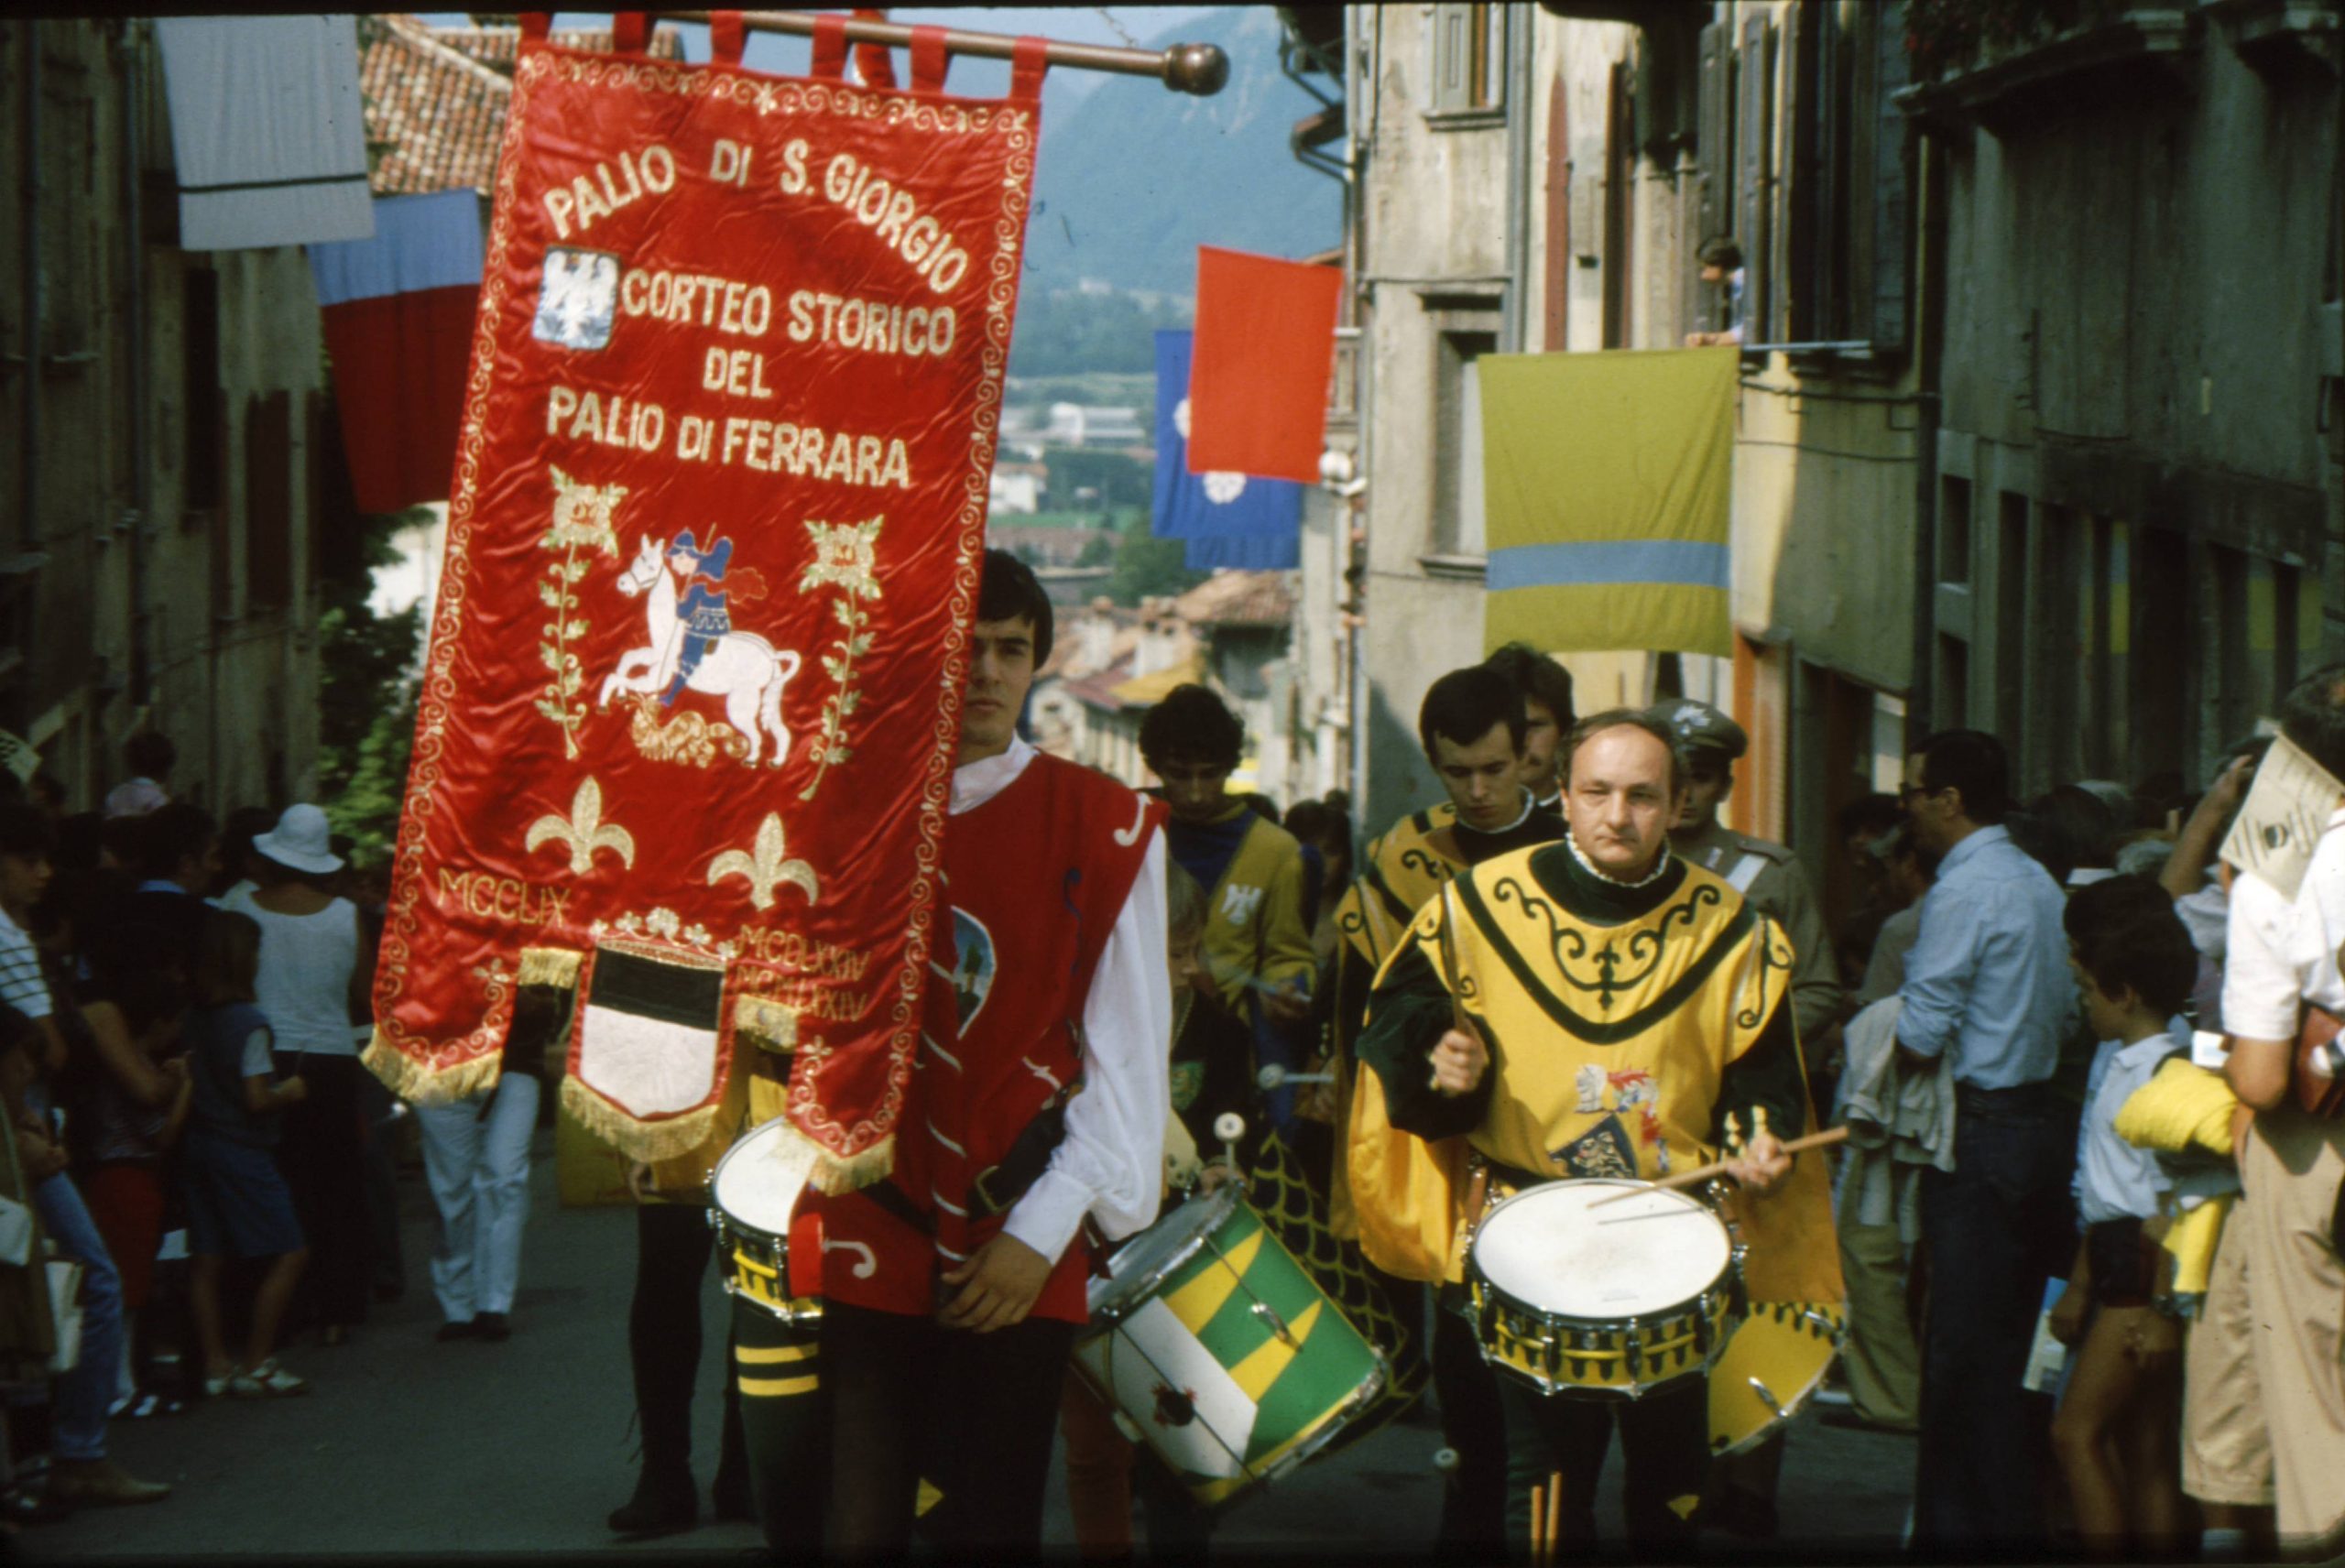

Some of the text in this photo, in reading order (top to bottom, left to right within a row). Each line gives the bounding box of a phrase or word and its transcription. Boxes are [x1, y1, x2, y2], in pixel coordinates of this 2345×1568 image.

[542, 137, 968, 294] PALIO DI S. GIORGIO
[620, 268, 956, 357] CORTEO STORICO
[702, 346, 773, 399] DEL
[546, 385, 910, 489] PALIO DI FERRARA
[437, 867, 573, 929] MCCLIX
